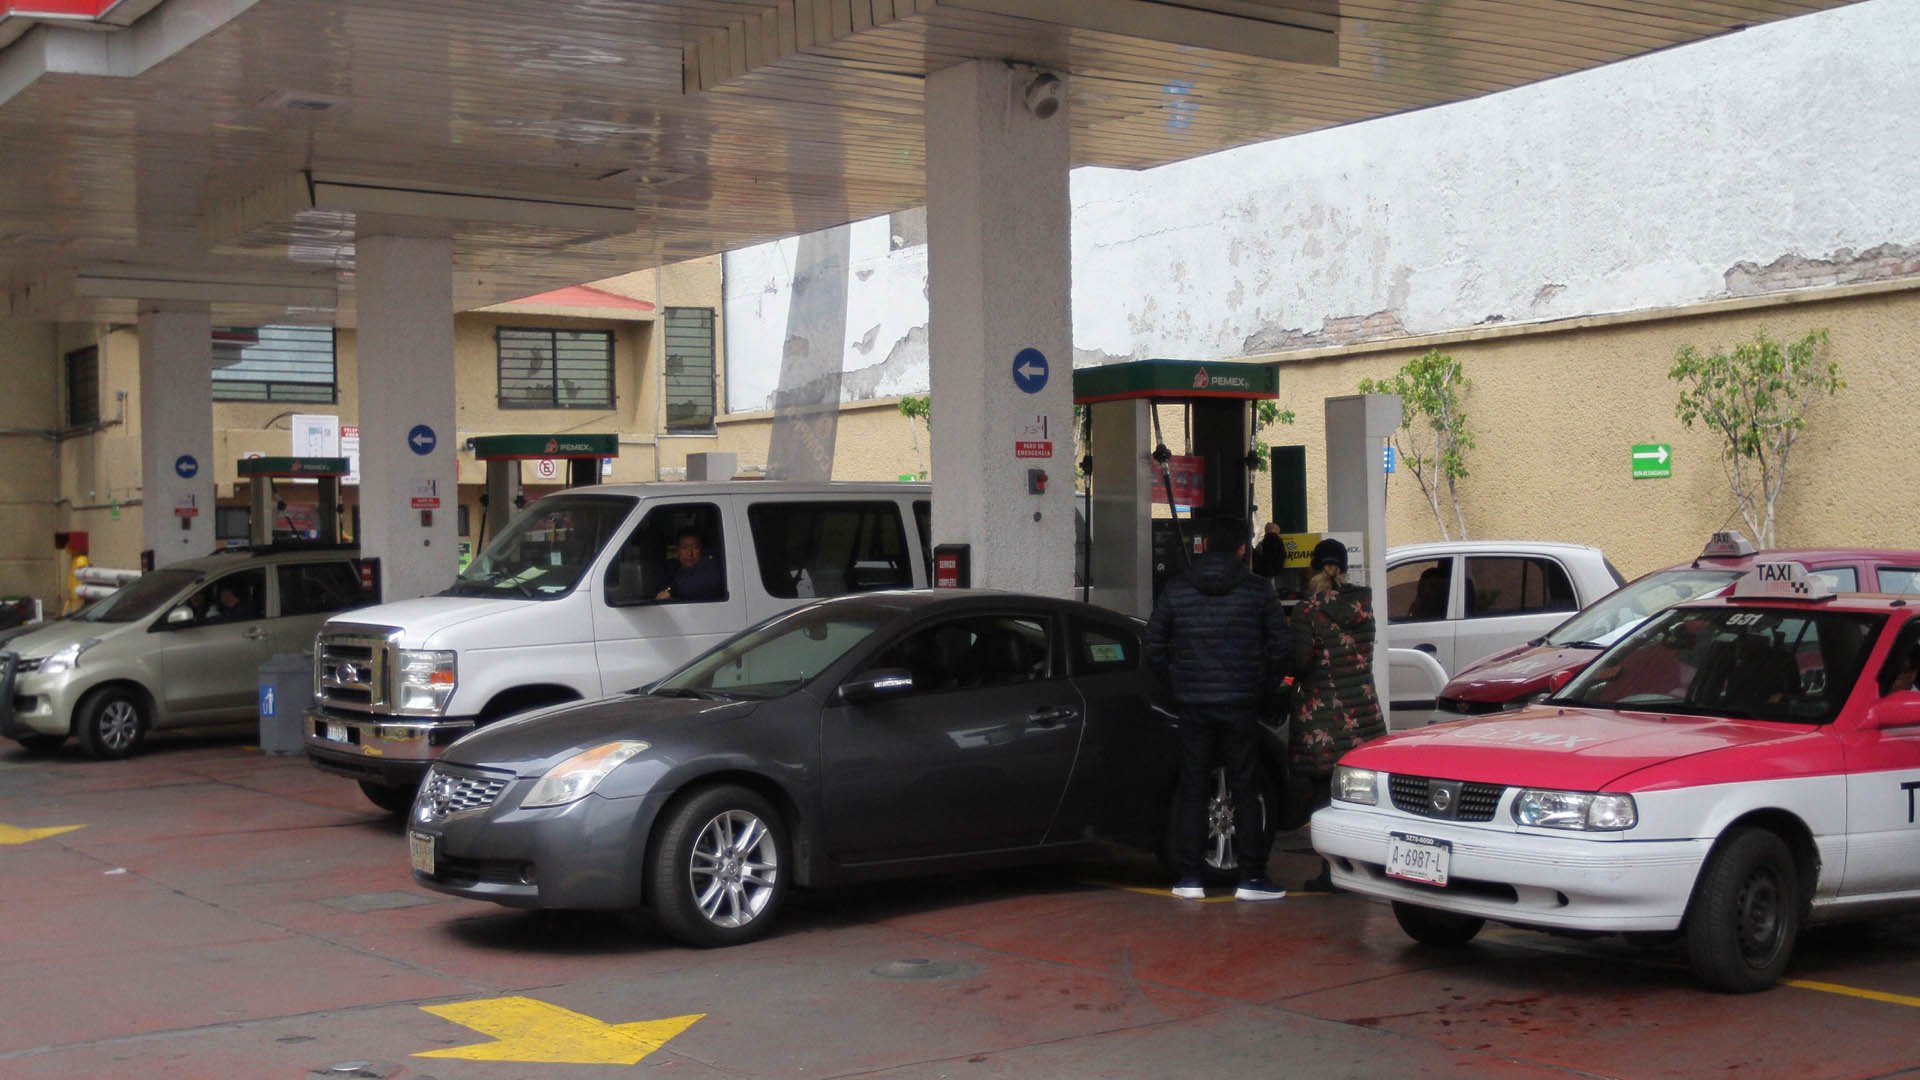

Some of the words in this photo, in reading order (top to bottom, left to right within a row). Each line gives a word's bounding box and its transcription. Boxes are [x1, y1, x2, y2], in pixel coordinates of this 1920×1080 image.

[1211, 376, 1246, 387] PEMEX
[560, 442, 590, 452] PEMEX
[1713, 532, 1730, 544] TAXI
[1756, 564, 1792, 581] TAXI
[1726, 613, 1764, 626] 931
[1392, 845, 1442, 872] A-6987-L
